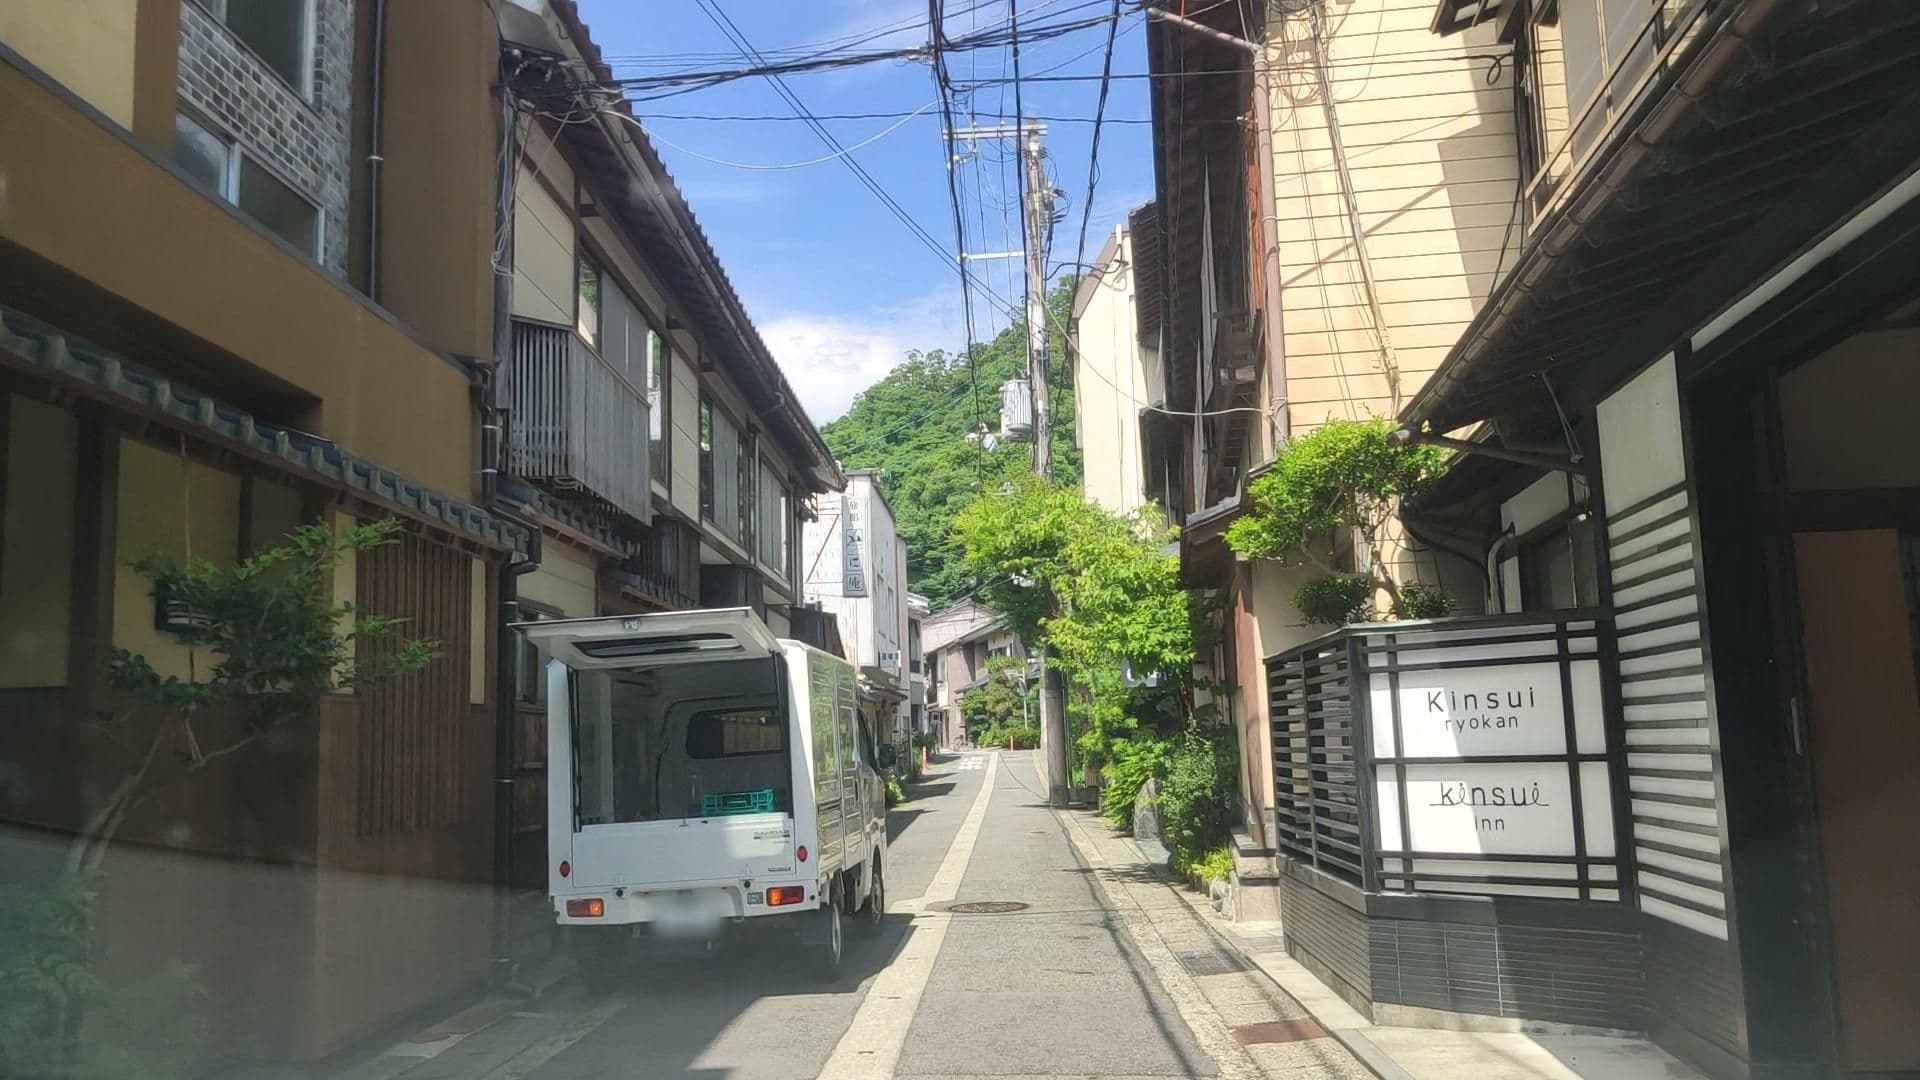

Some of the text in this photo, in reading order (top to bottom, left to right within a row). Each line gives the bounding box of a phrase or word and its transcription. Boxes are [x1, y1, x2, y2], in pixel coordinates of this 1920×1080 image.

[1427, 686, 1535, 713] Kinsui
[1444, 714, 1519, 734] ryokan
[1430, 781, 1549, 807] kinsui
[1474, 816, 1505, 832] inn
